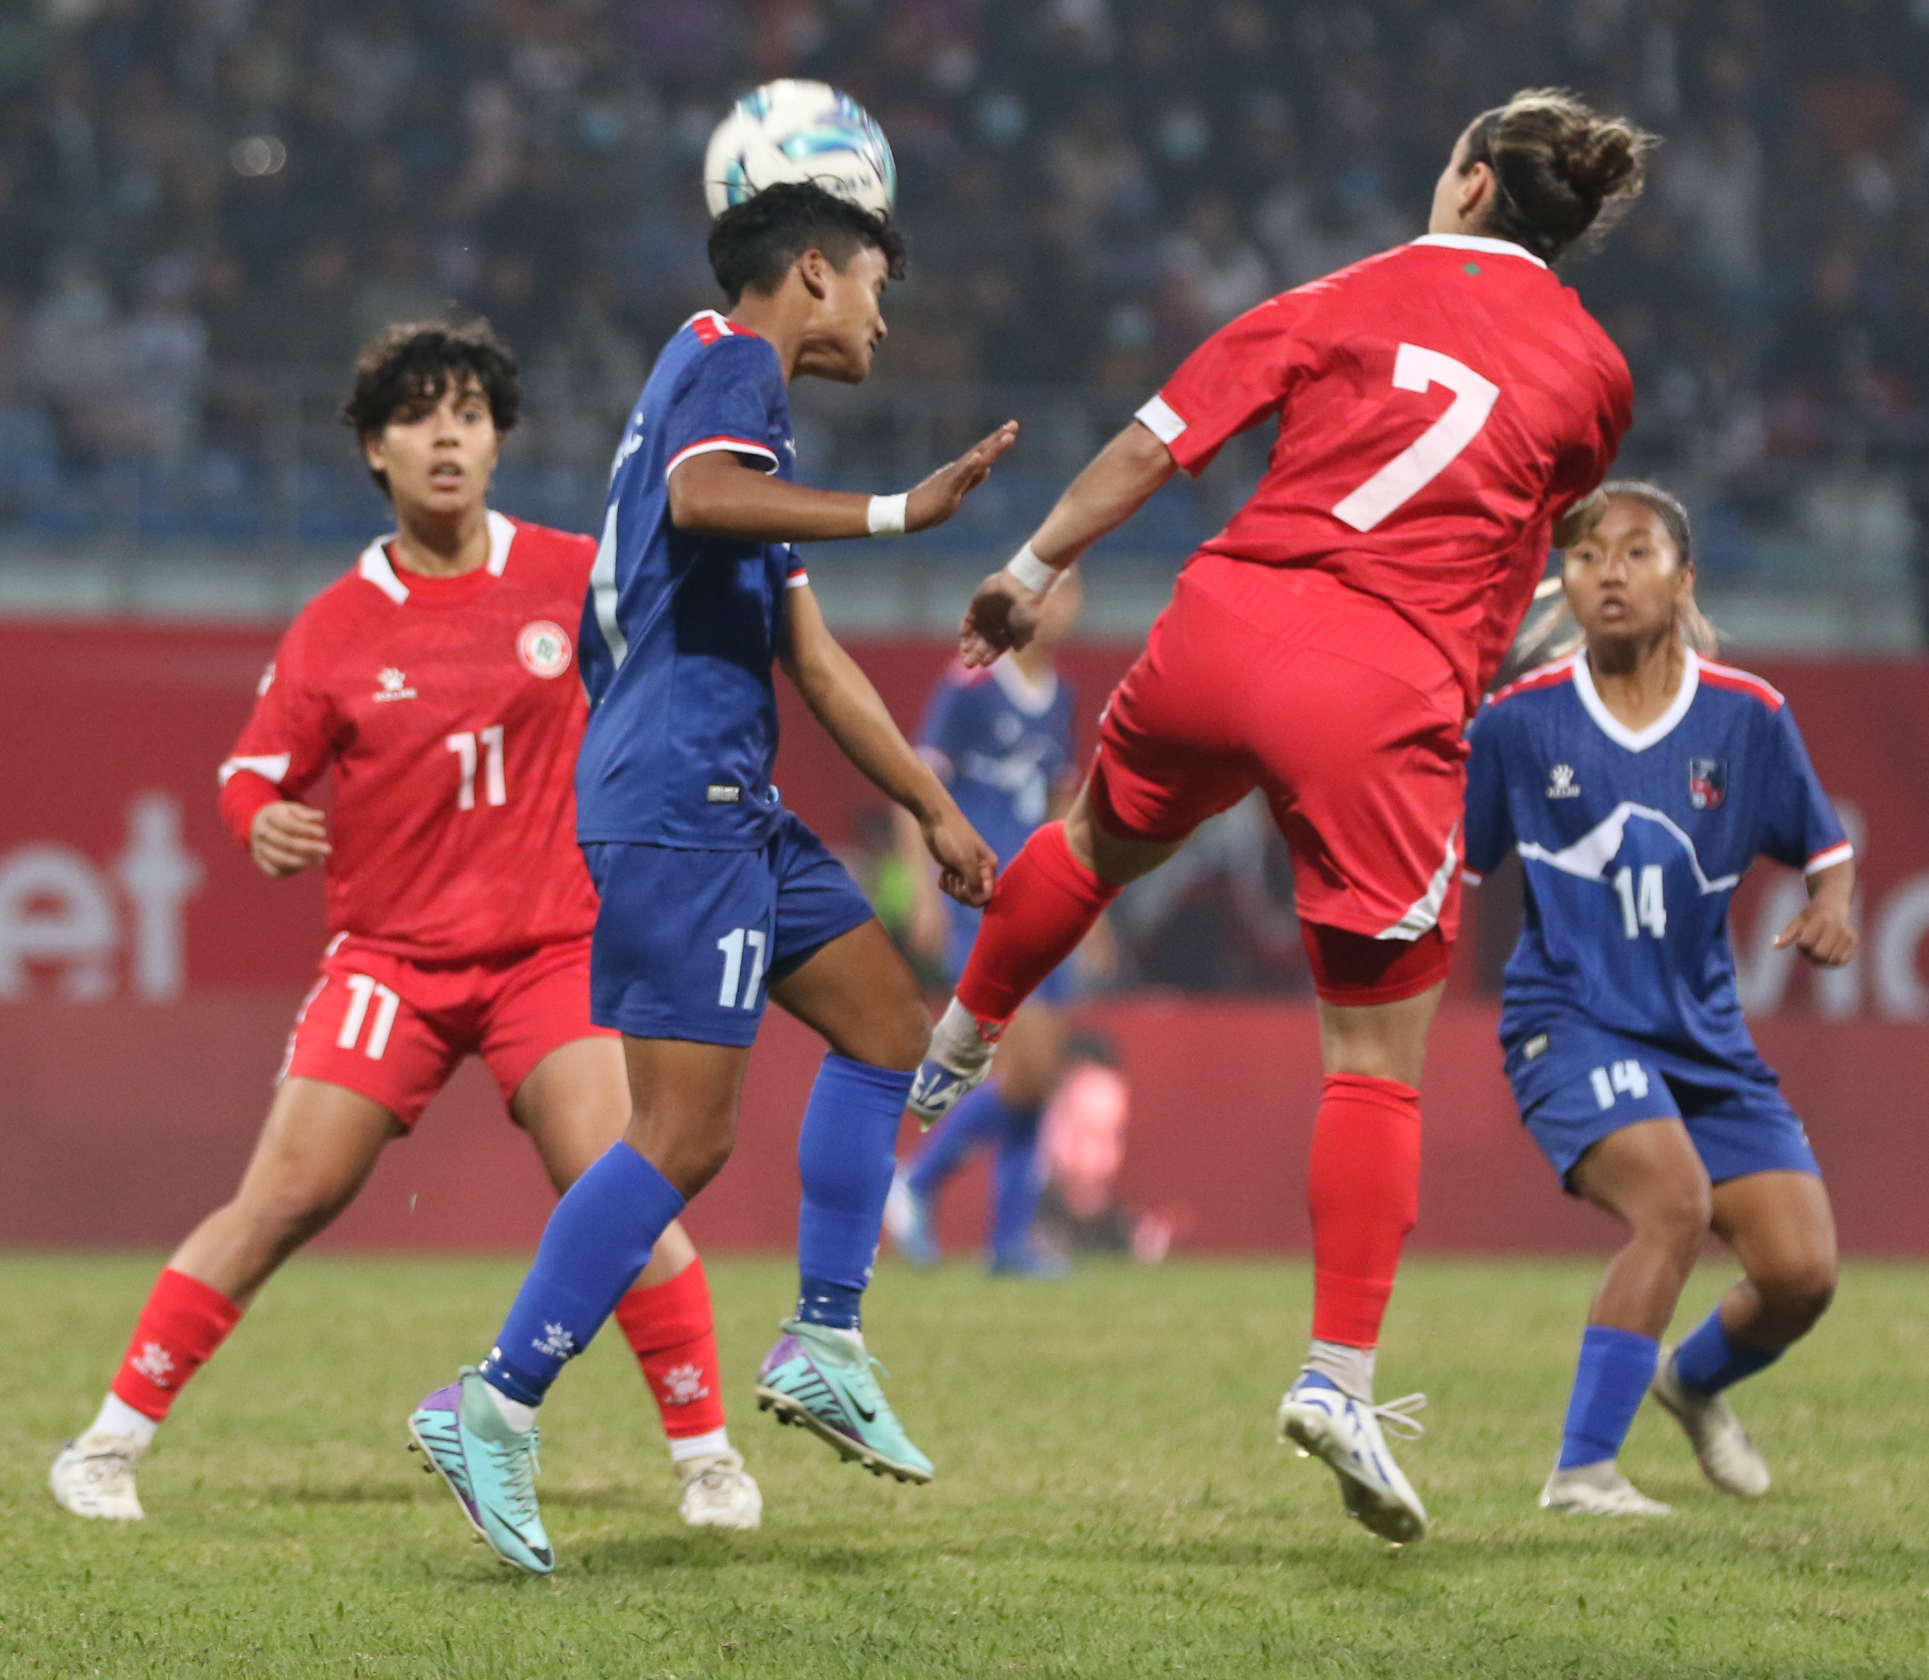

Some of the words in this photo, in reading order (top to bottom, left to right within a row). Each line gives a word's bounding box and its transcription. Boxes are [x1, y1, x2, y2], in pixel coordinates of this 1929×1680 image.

[1332, 342, 1501, 533] 7
[446, 724, 507, 811] 11
[1614, 864, 1666, 939] 14
[717, 928, 766, 1010] 17
[336, 973, 400, 1060] 11
[1590, 1059, 1648, 1111] 14
